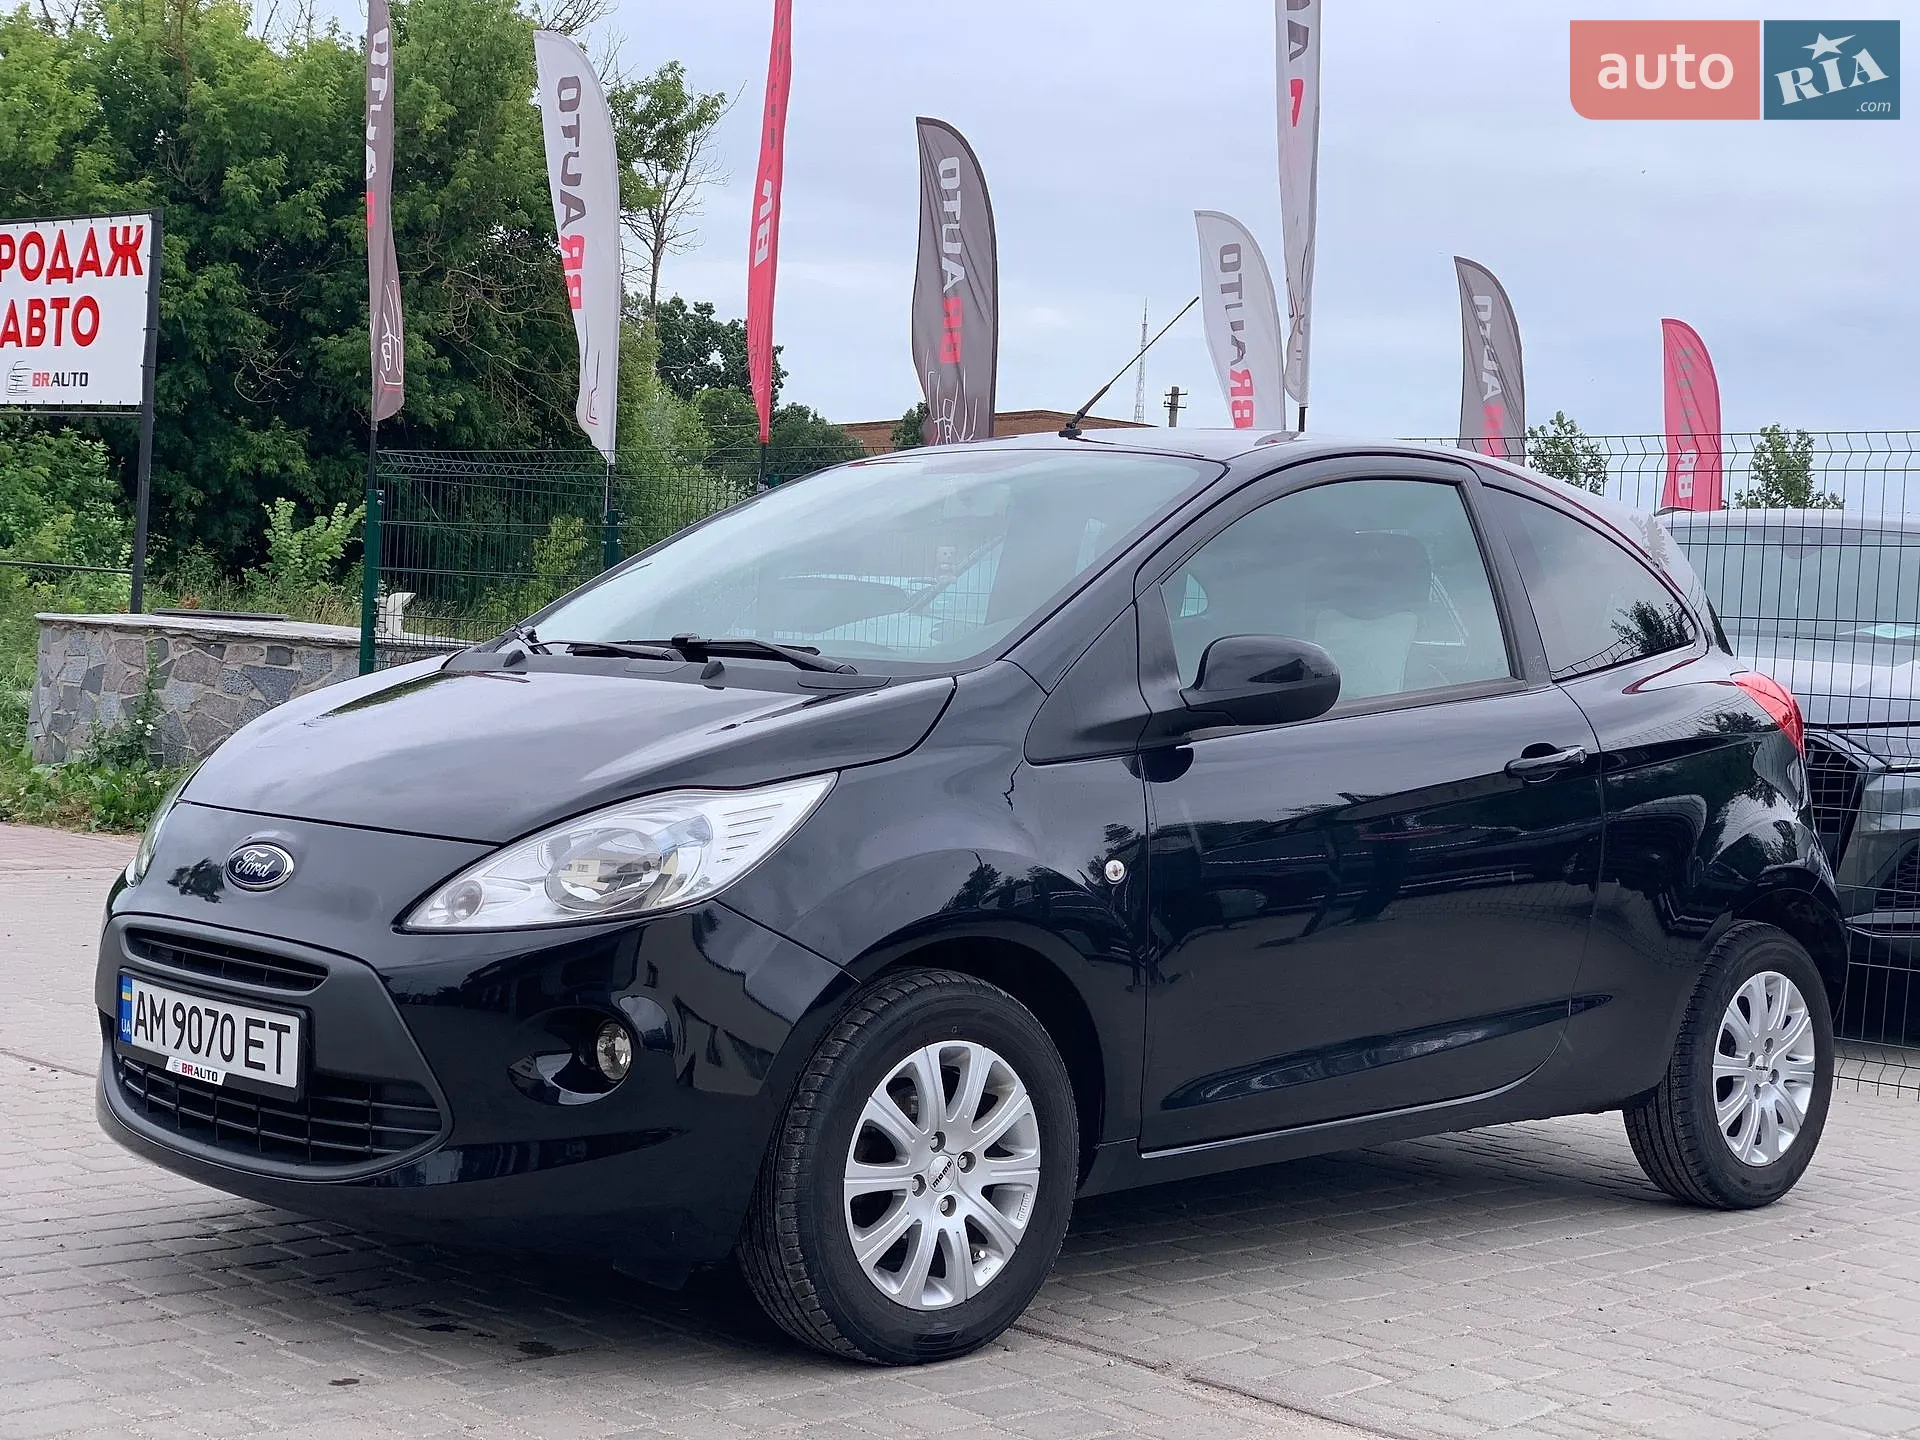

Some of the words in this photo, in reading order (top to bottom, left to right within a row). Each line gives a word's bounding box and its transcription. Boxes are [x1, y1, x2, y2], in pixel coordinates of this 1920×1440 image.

[0, 295, 100, 348] АВТО
[32, 371, 89, 387] BRAUTO
[234, 851, 273, 878] Ford
[121, 1017, 131, 1034] UA
[133, 990, 167, 1046] AM
[172, 1001, 236, 1062] 9070
[244, 1016, 291, 1075] ET
[181, 1062, 218, 1083] BRAUTO
